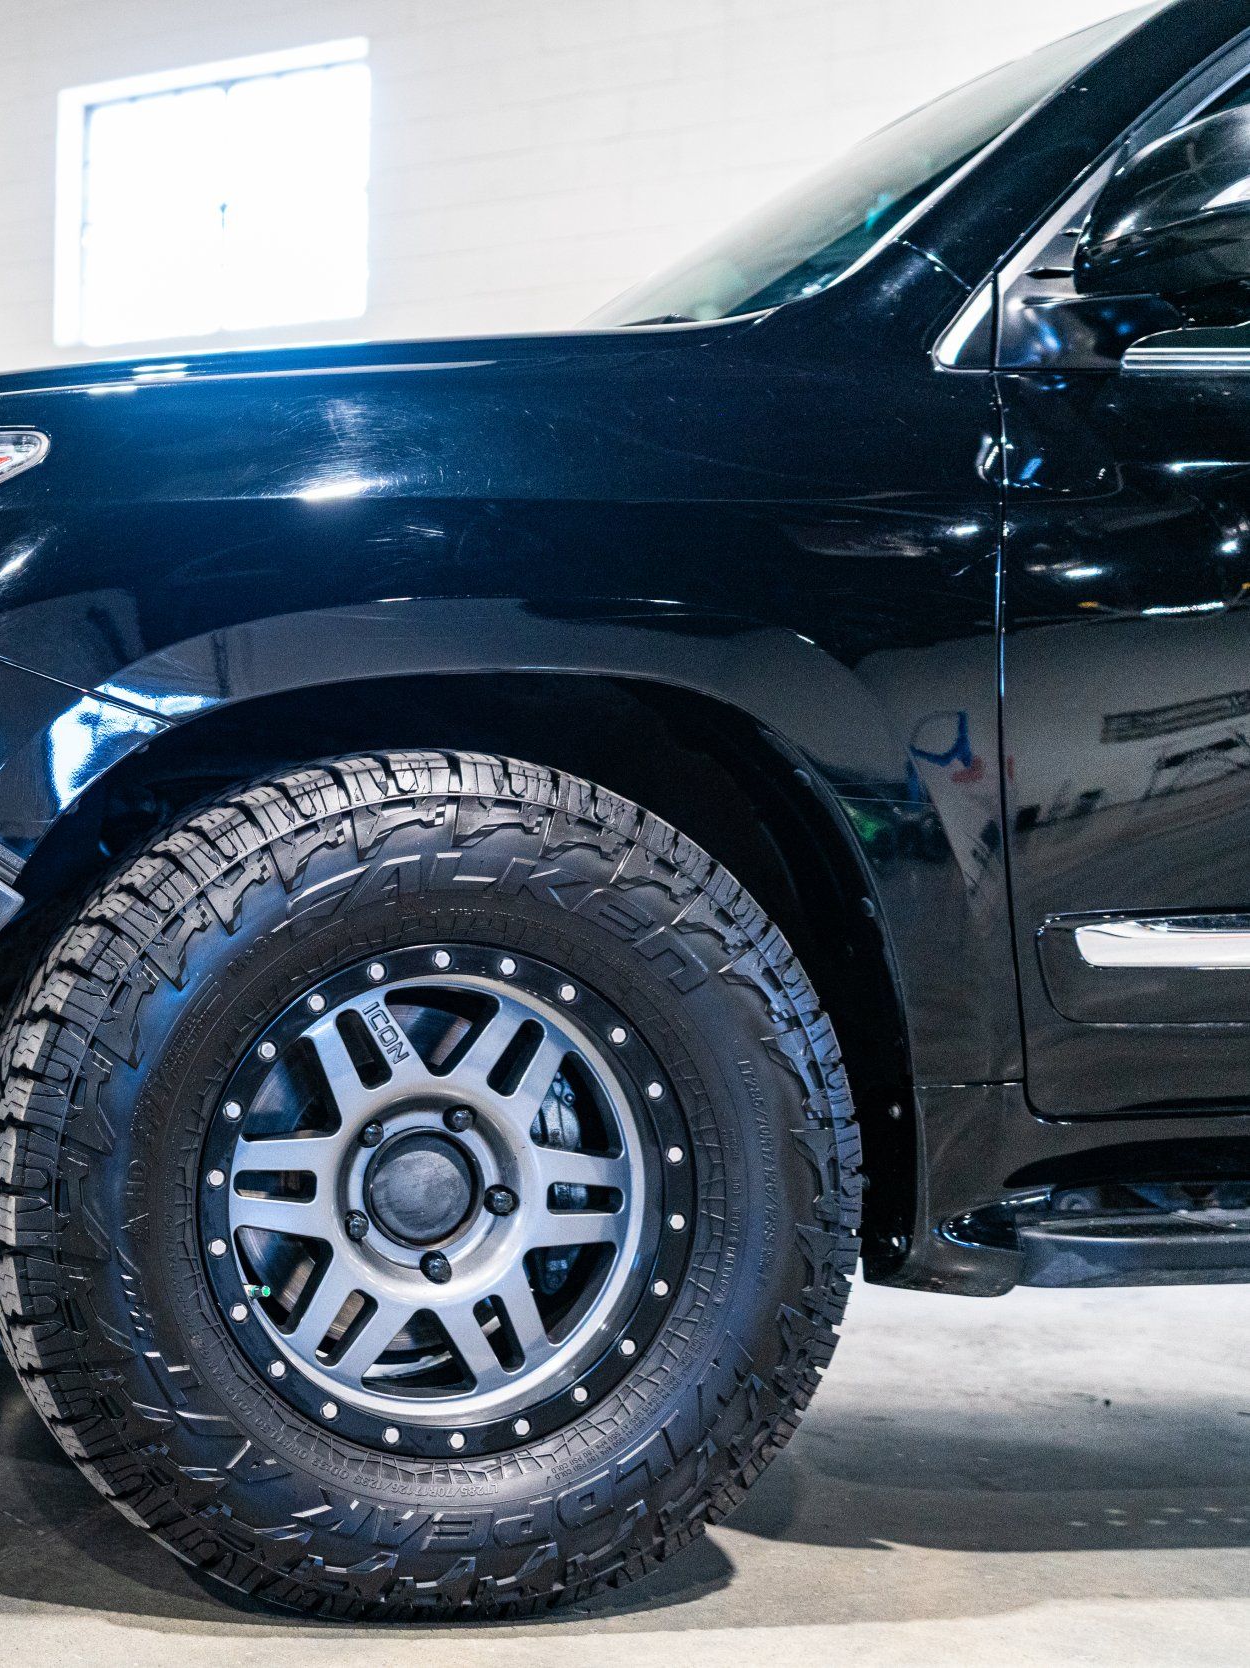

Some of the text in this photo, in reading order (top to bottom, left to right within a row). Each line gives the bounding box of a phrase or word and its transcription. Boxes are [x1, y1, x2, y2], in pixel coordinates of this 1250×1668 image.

[271, 853, 709, 995] FALKEN
[362, 1001, 410, 1065] ICON
[289, 1330, 754, 1556] WILDPEAK
[550, 1461, 568, 1474] COLD
[553, 1467, 572, 1481] COLD
